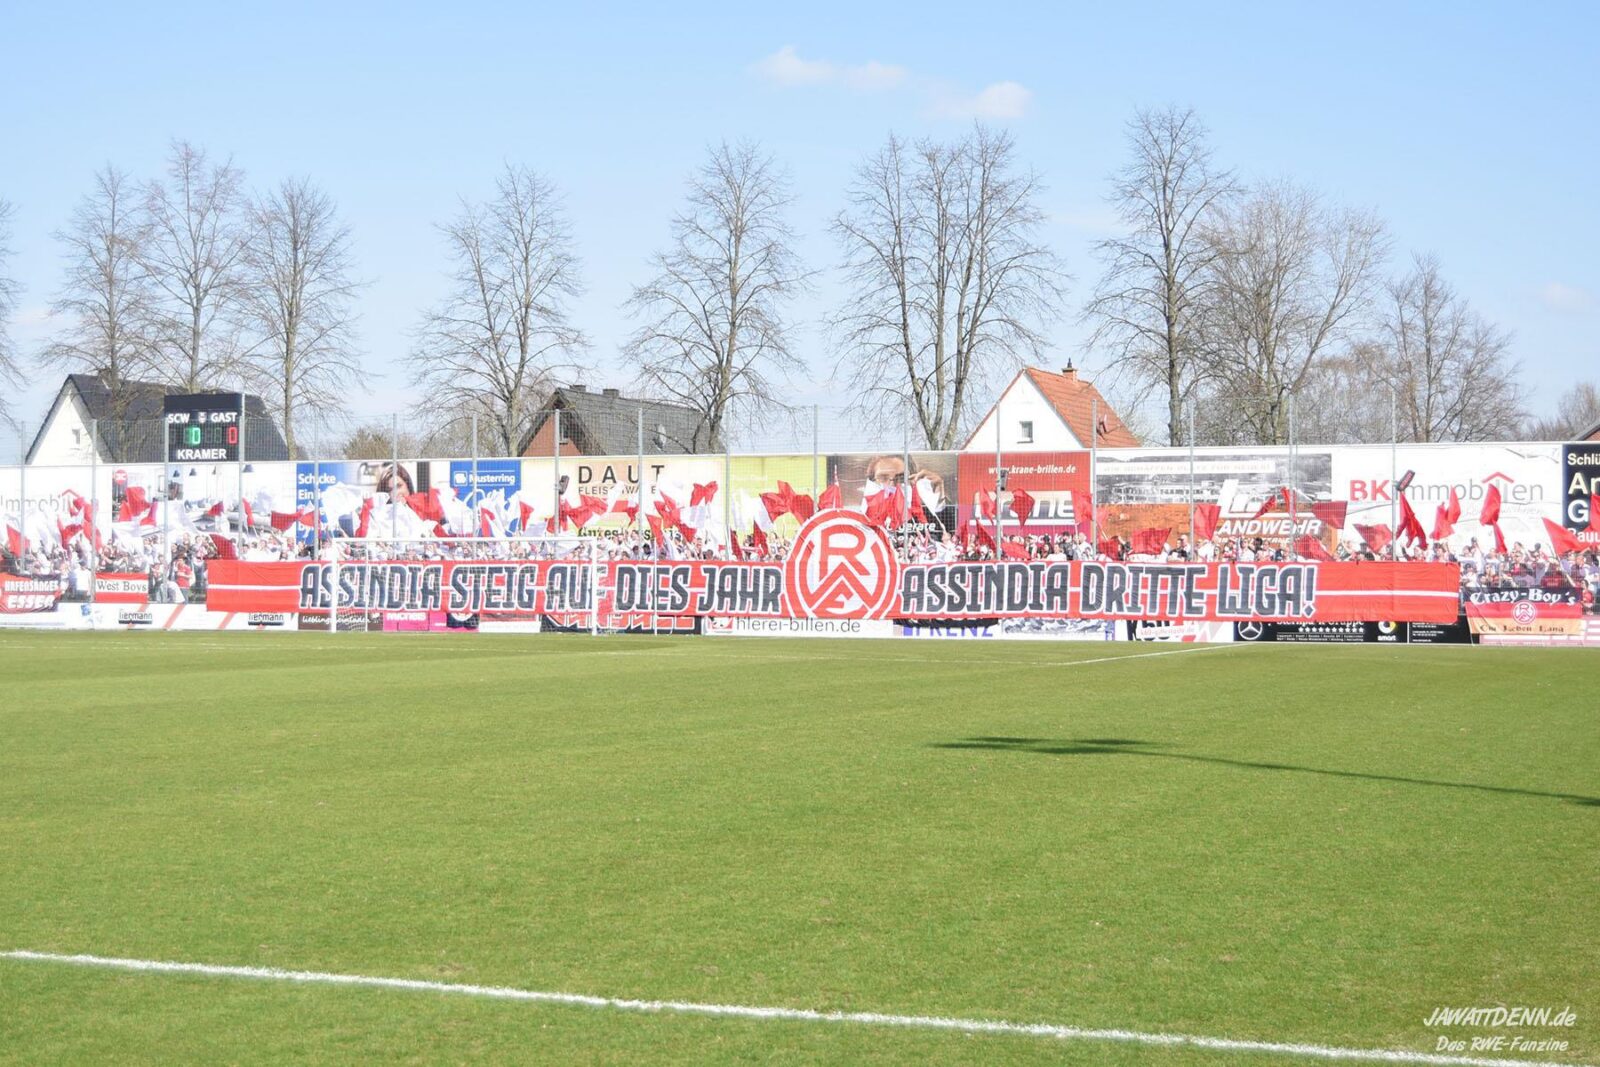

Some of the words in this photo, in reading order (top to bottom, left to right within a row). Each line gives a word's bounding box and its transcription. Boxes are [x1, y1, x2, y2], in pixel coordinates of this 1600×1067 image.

[167, 413, 190, 424] SCW
[211, 412, 238, 423] GAST
[192, 427, 201, 445] 0
[228, 426, 238, 445] 0
[177, 449, 227, 460] KRAMER
[988, 464, 1076, 475] w.krane-brillen.de
[298, 473, 336, 485] Schcke
[1350, 479, 1392, 501] BK
[1396, 478, 1544, 501] mmoblien
[1214, 519, 1321, 535] ANDWEHR
[97, 581, 119, 591] West
[300, 565, 442, 609] ASSINDIA
[450, 565, 537, 610] STEIG
[545, 565, 609, 611] AUF
[615, 566, 691, 612] DIES
[697, 566, 783, 613] JAHR
[901, 565, 1070, 614] ASSINDIA
[1081, 564, 1208, 616] DRITTE
[1216, 565, 1317, 617] LIGA!
